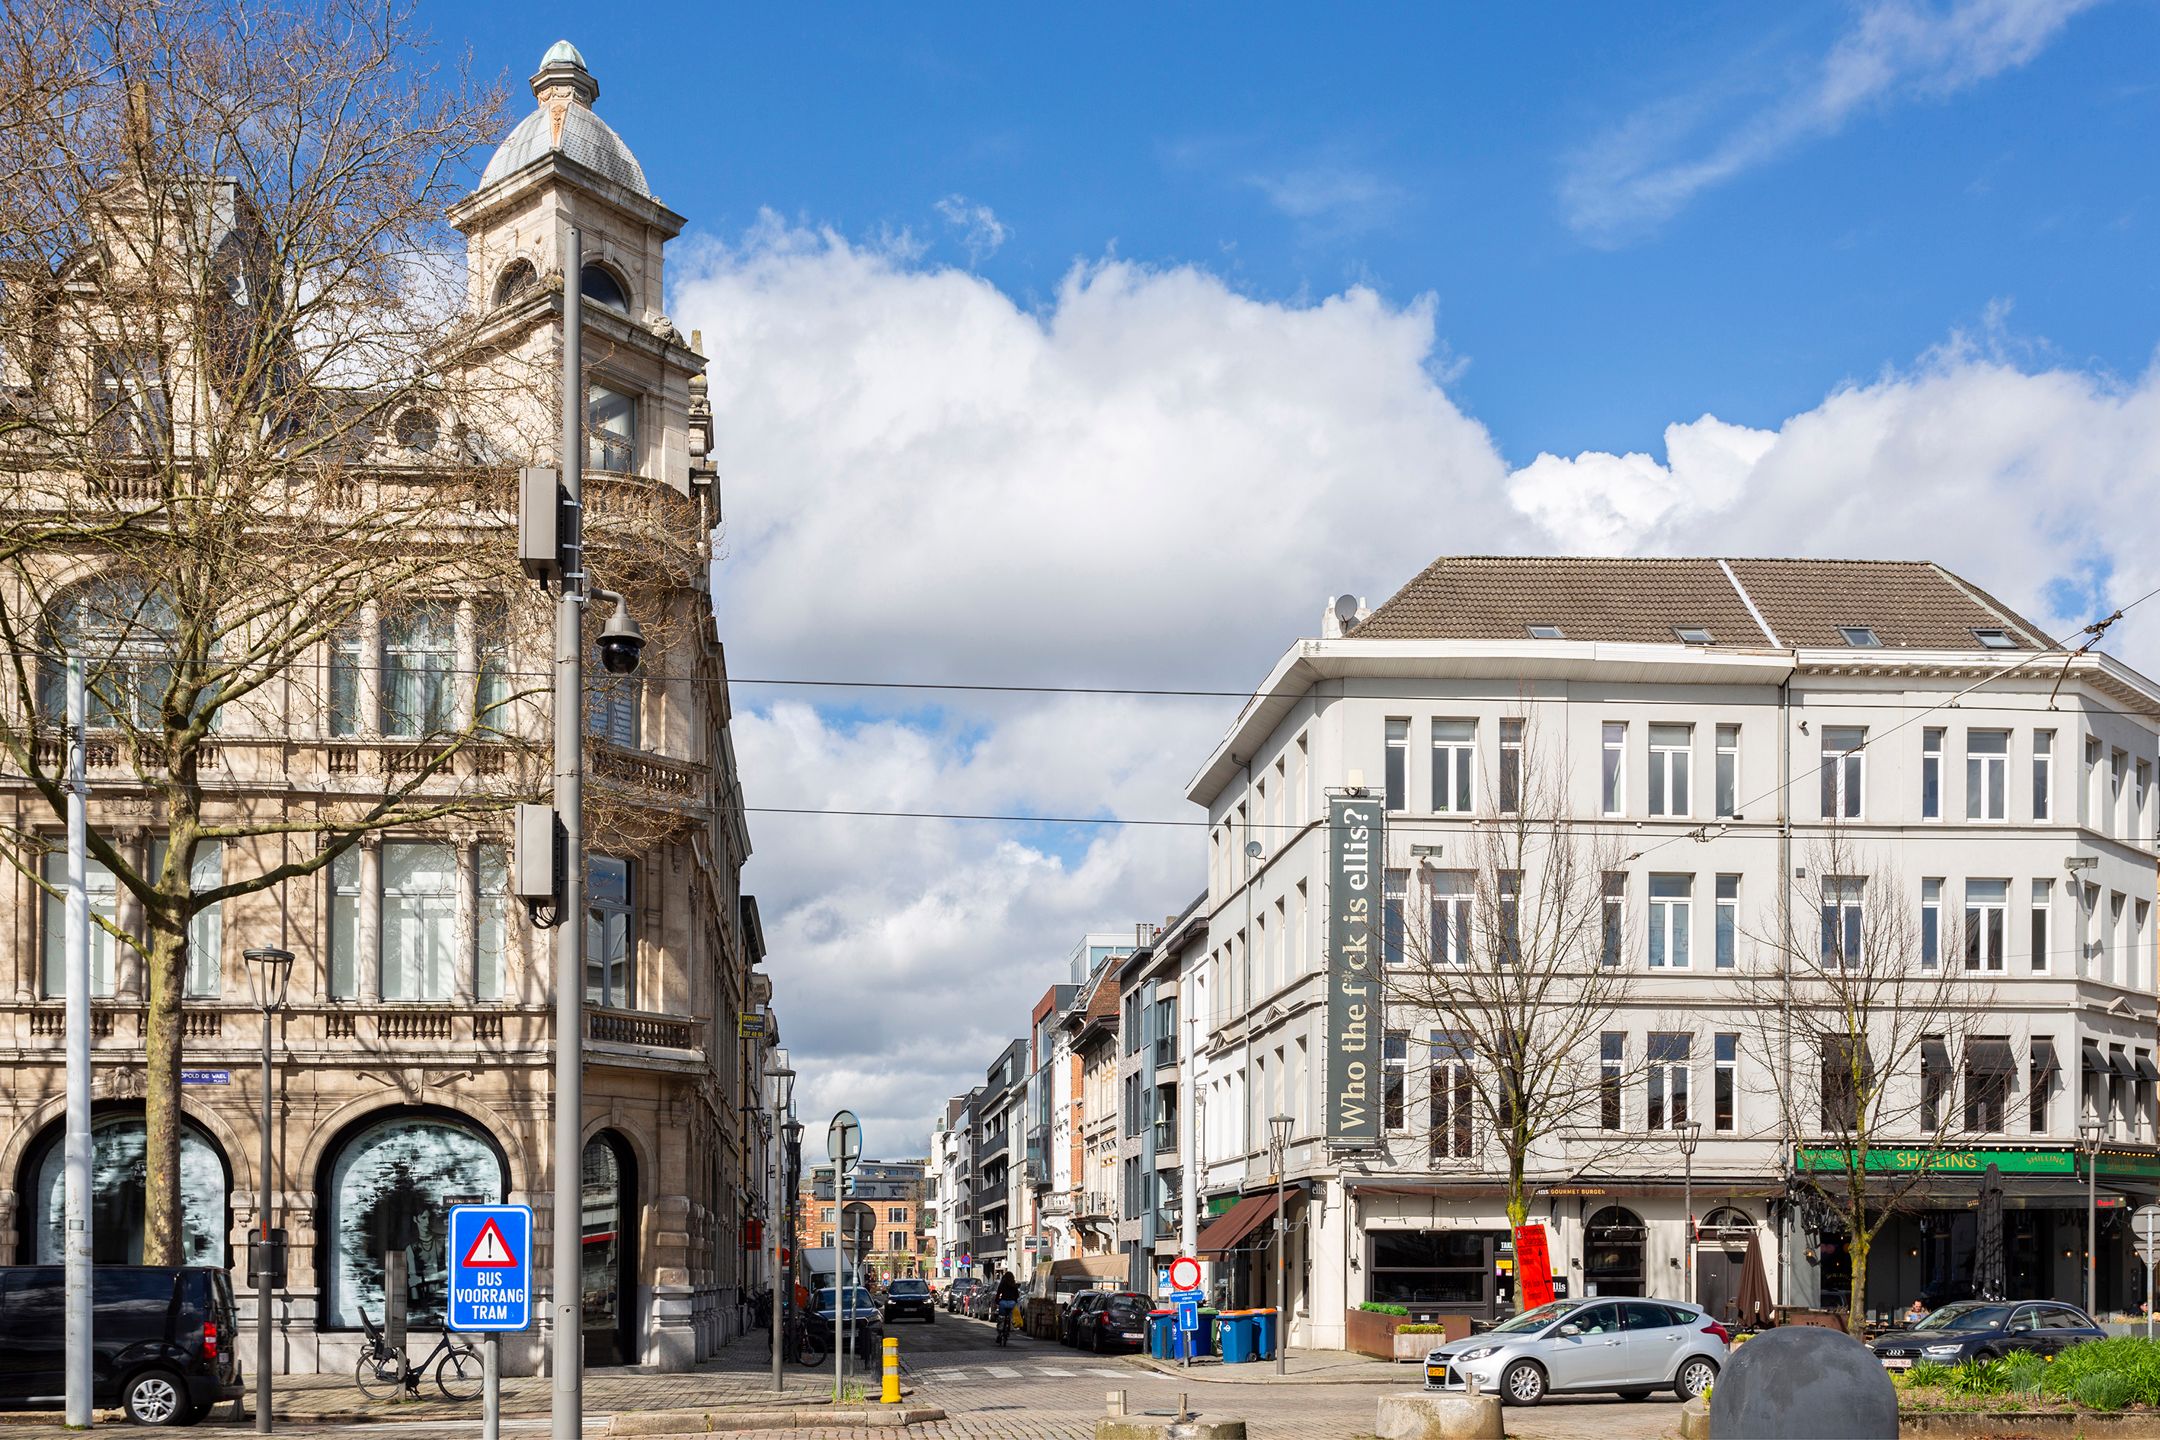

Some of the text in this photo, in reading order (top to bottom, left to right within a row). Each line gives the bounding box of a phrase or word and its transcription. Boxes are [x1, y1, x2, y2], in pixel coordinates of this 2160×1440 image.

[1343, 807, 1369, 891] ellis?
[1342, 897, 1368, 924] is
[1341, 1004, 1367, 1053] the
[1340, 1061, 1366, 1132] Who
[1896, 1152, 1978, 1169] SHILLING
[2025, 1154, 2066, 1166] SHILLING
[1311, 1183, 1327, 1195] ellis
[477, 1272, 502, 1287] BUS
[456, 1288, 524, 1303] VOORRANG
[472, 1305, 507, 1320] TRAM
